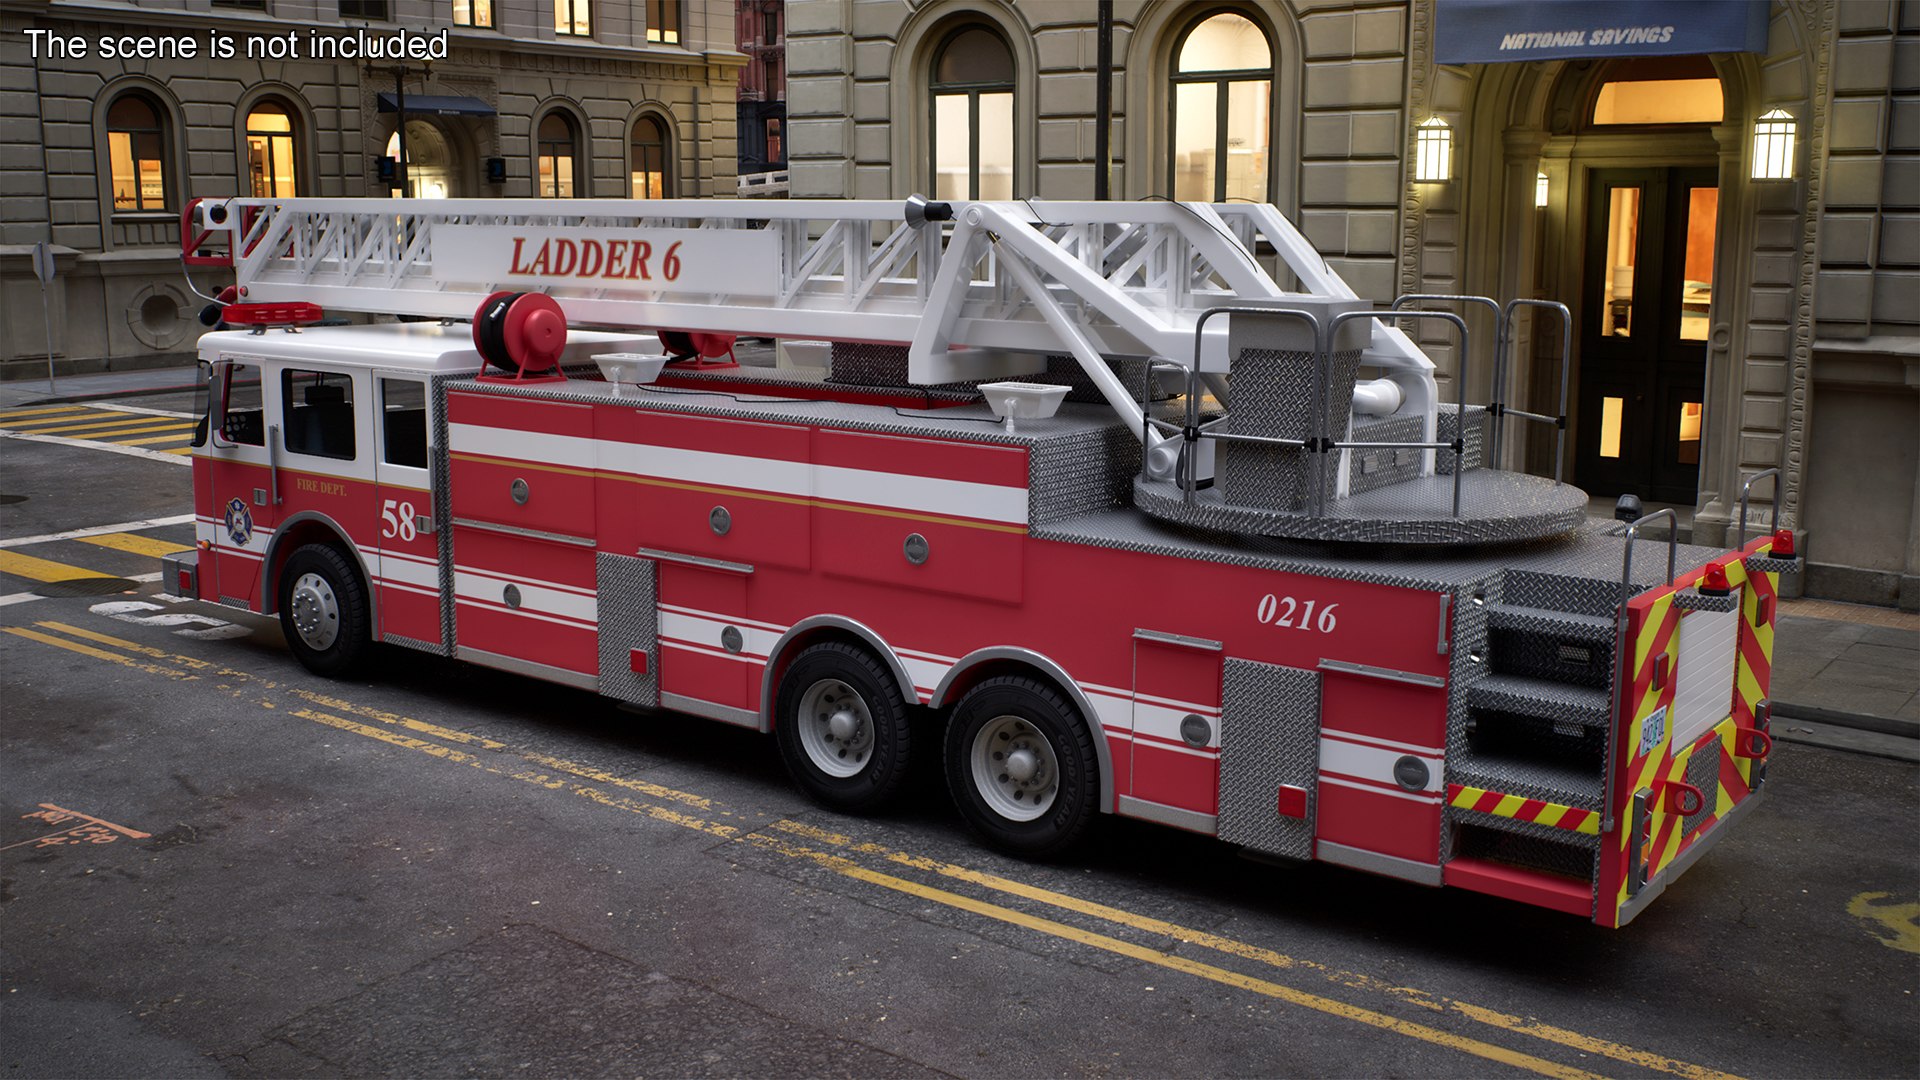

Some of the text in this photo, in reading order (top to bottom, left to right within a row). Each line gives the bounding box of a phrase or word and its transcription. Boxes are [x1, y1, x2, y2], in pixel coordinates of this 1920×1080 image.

[1499, 26, 1675, 51] NATIONAL SAVINGS
[508, 237, 683, 282] LADDER 6
[296, 478, 348, 497] FIRE DEPT.
[382, 499, 416, 541] 58
[1257, 593, 1339, 633] 0216
